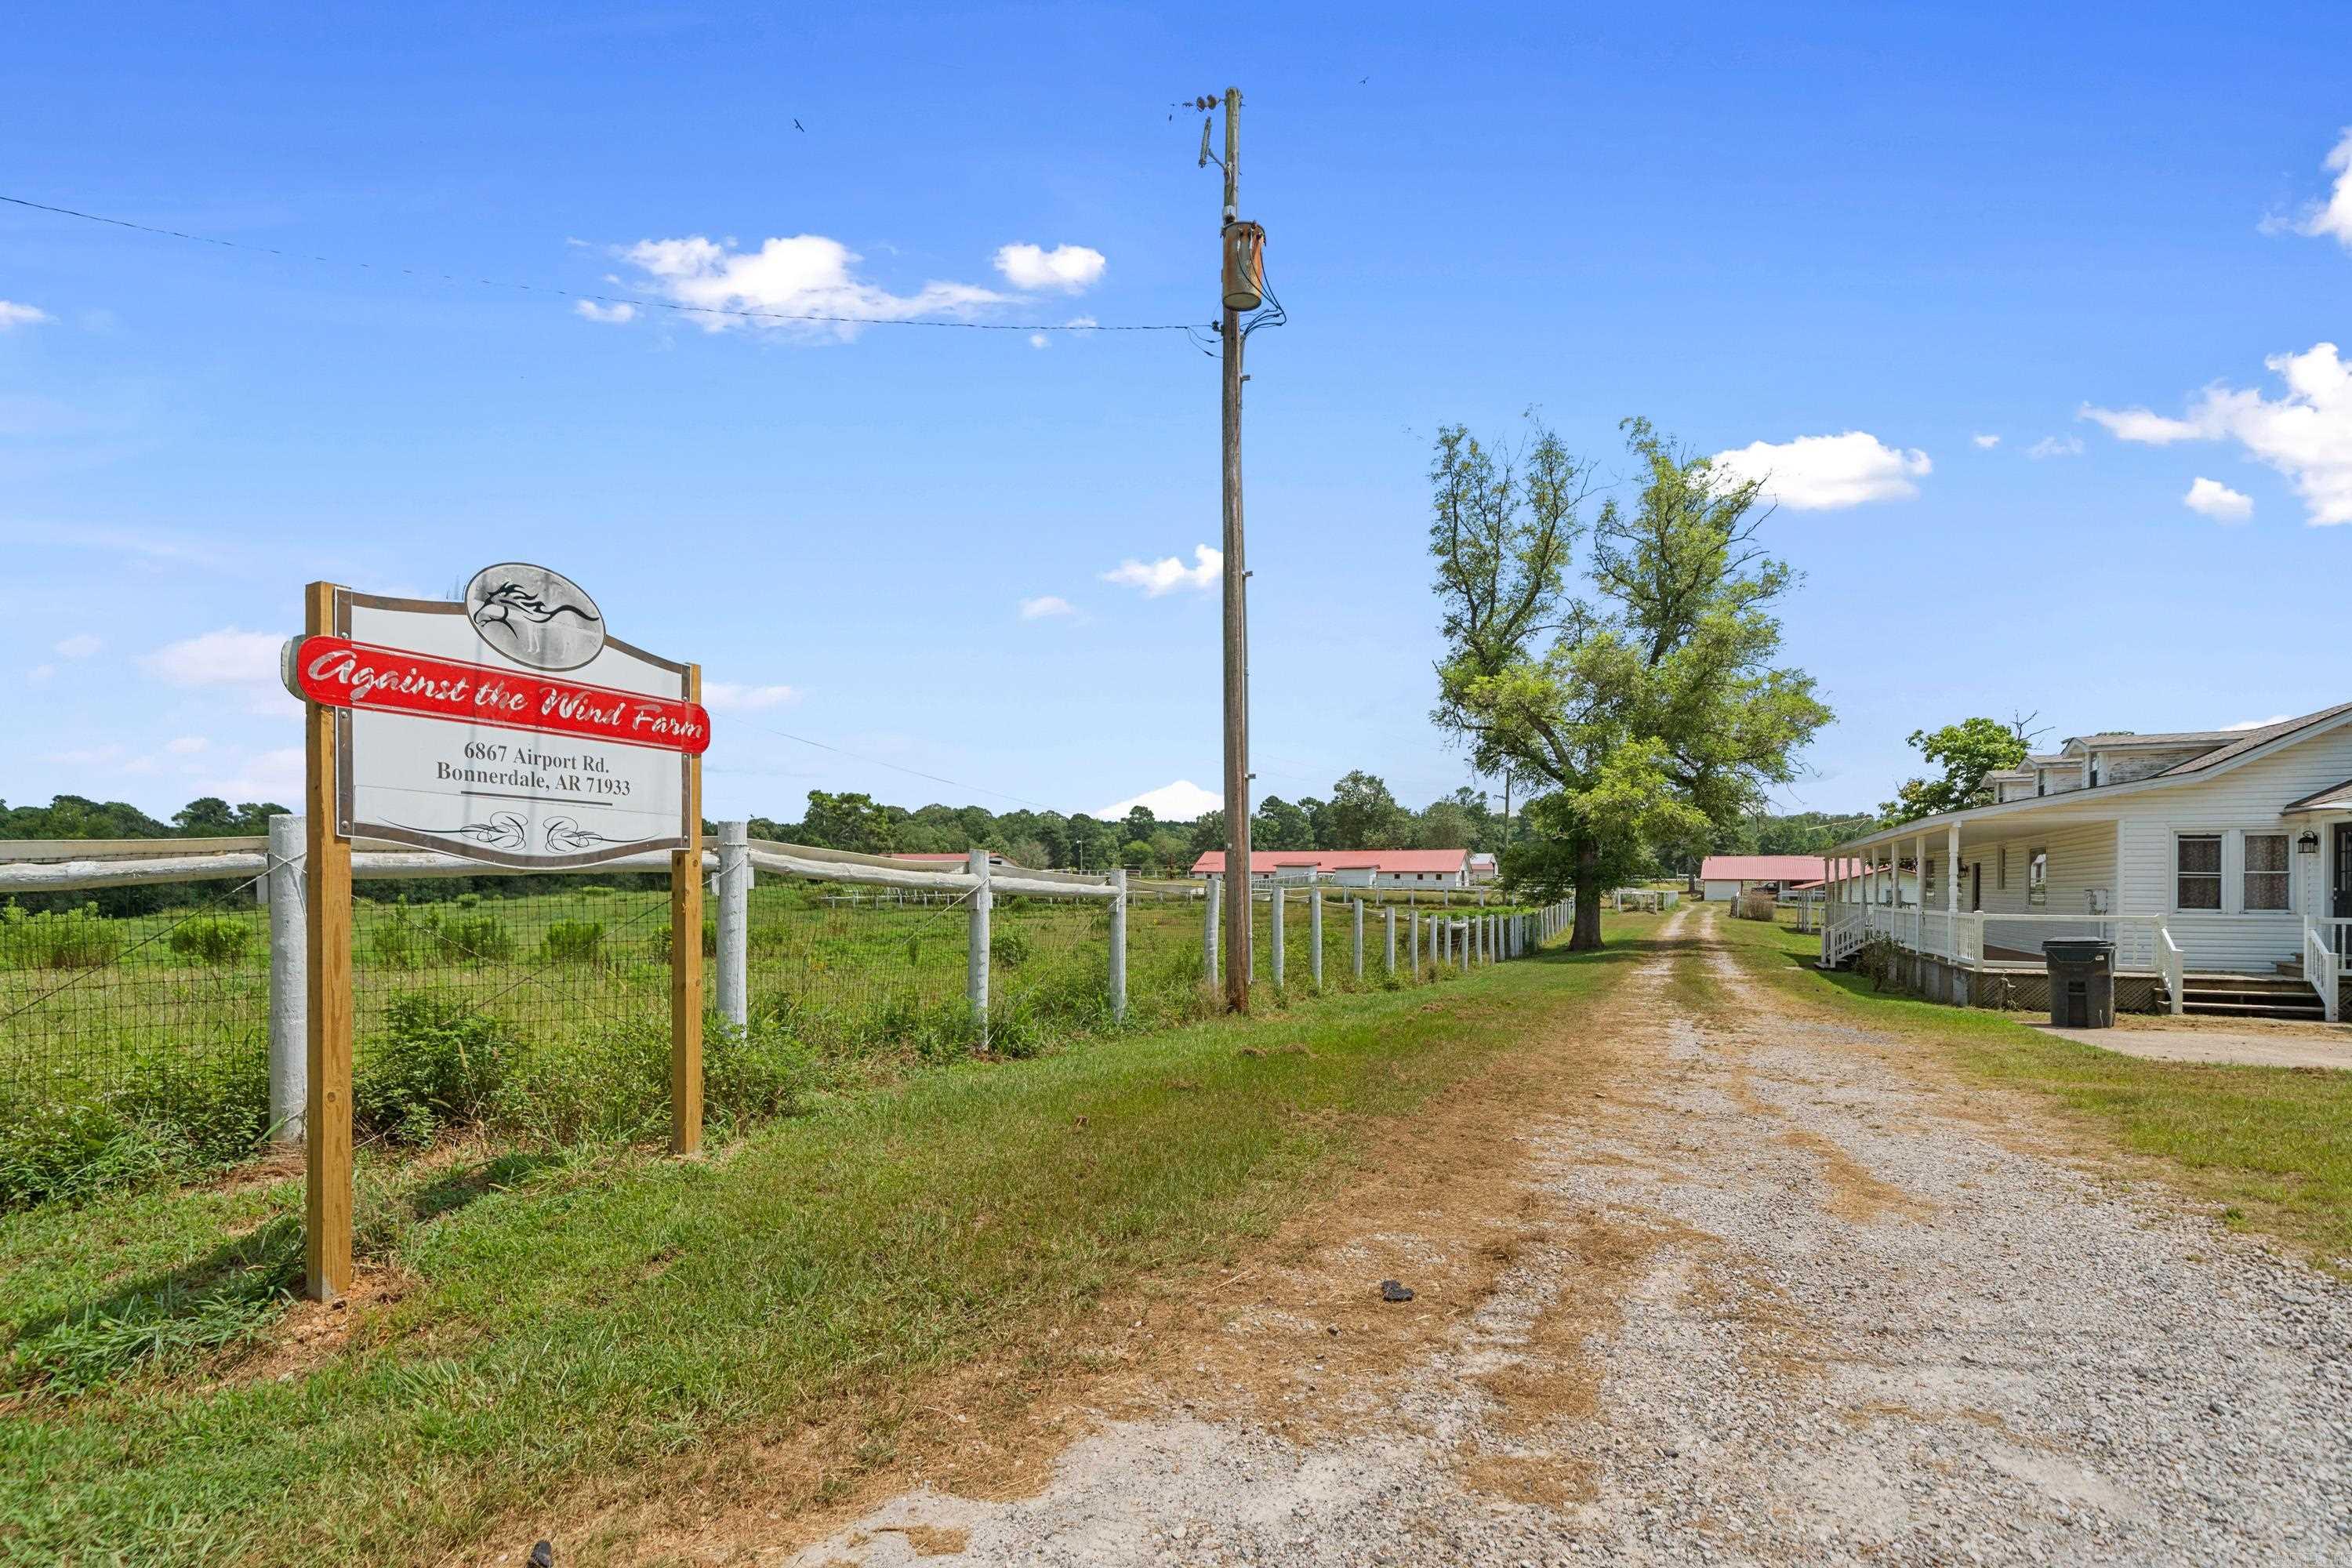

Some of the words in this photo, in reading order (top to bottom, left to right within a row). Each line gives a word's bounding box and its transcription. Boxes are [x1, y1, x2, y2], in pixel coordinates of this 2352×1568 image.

[308, 650, 469, 701] Against
[474, 677, 528, 711] the
[539, 688, 626, 726] Wind
[633, 706, 703, 738] Farm
[464, 742, 507, 762] 6867
[514, 747, 576, 771] Airport
[583, 755, 609, 773] Rd.
[437, 761, 550, 790] Bonnerdale,
[555, 774, 581, 792] AR
[586, 777, 631, 796] 71933
